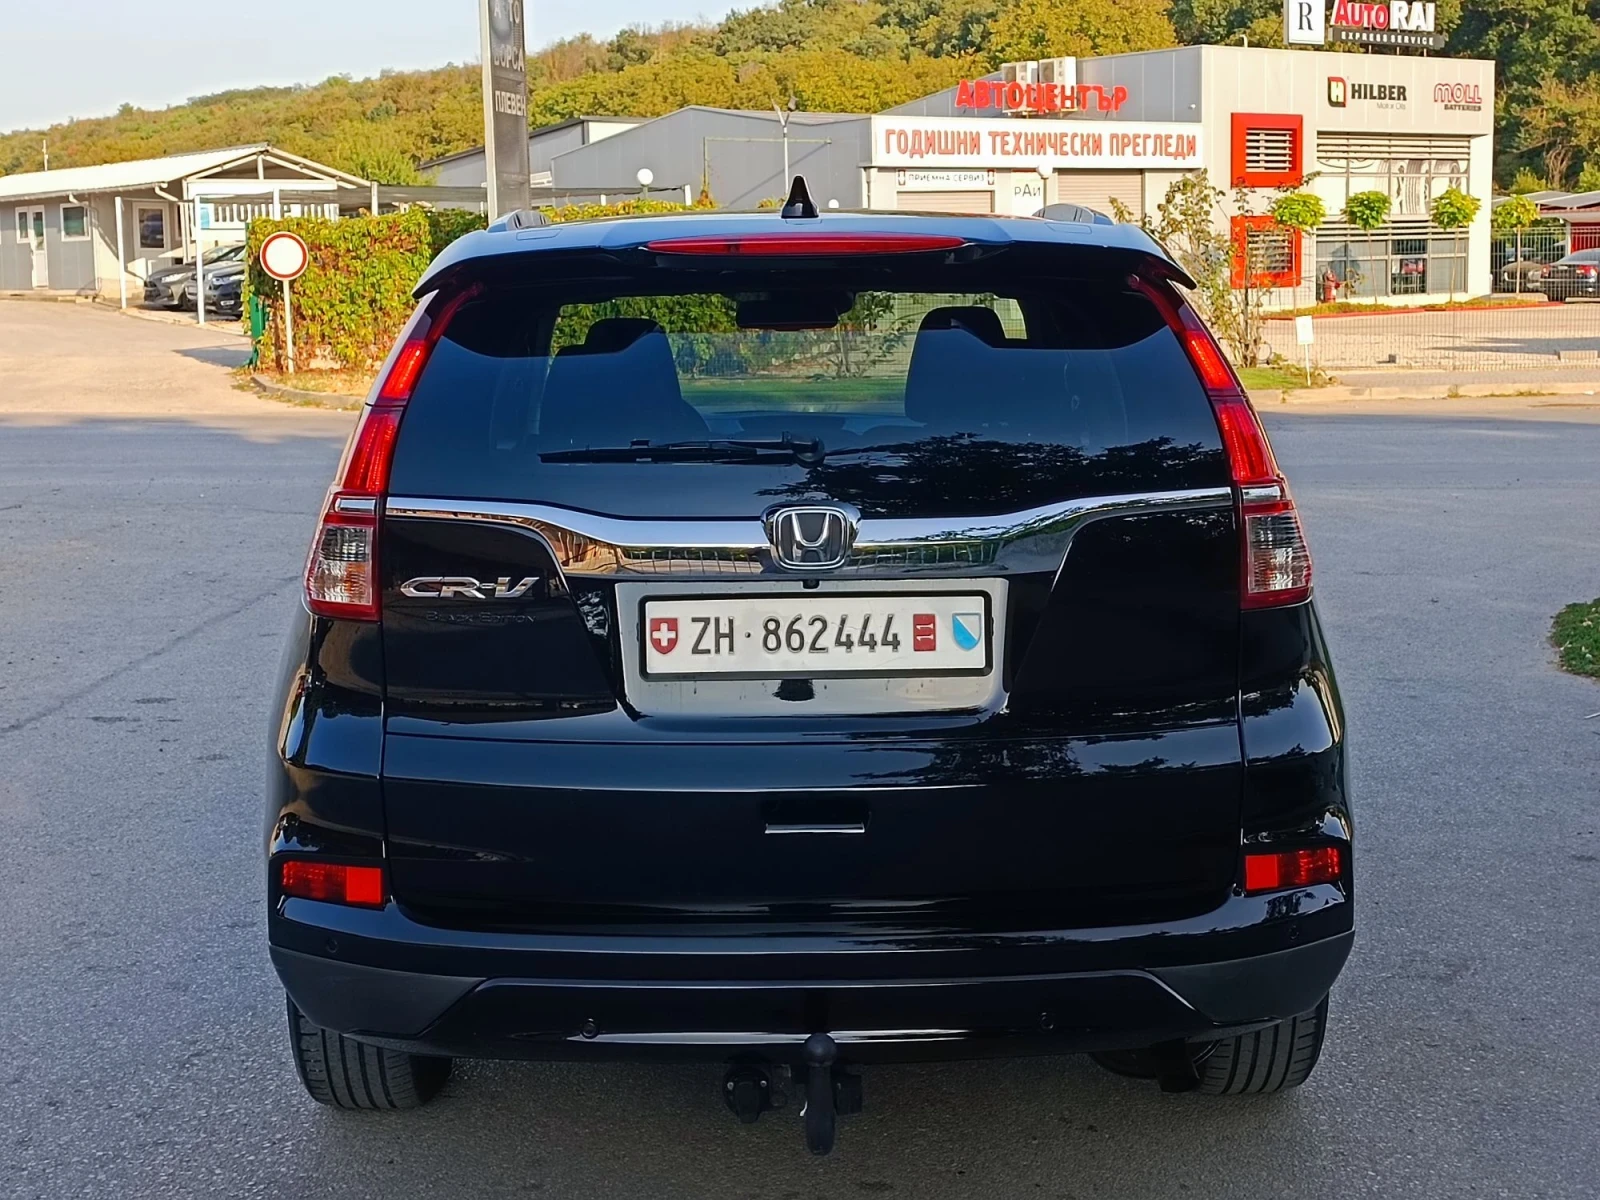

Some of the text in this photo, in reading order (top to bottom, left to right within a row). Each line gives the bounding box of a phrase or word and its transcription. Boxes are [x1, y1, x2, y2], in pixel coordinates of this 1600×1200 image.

[1298, 2, 1313, 31] R
[1341, 31, 1434, 46] EXPRESS SERVICE
[495, 91, 526, 116] ПЛЕВЕН
[954, 78, 1129, 114] АВТОЦЕНТЪР
[1351, 83, 1407, 101] HILBER
[1433, 82, 1482, 104] MOLL
[885, 129, 1197, 160] ГОДИШНИ ТЕХНИЧЕСКИ ПРЕГЛЕДИ
[400, 576, 540, 599] CR-V
[690, 613, 901, 655] ZH 862444
